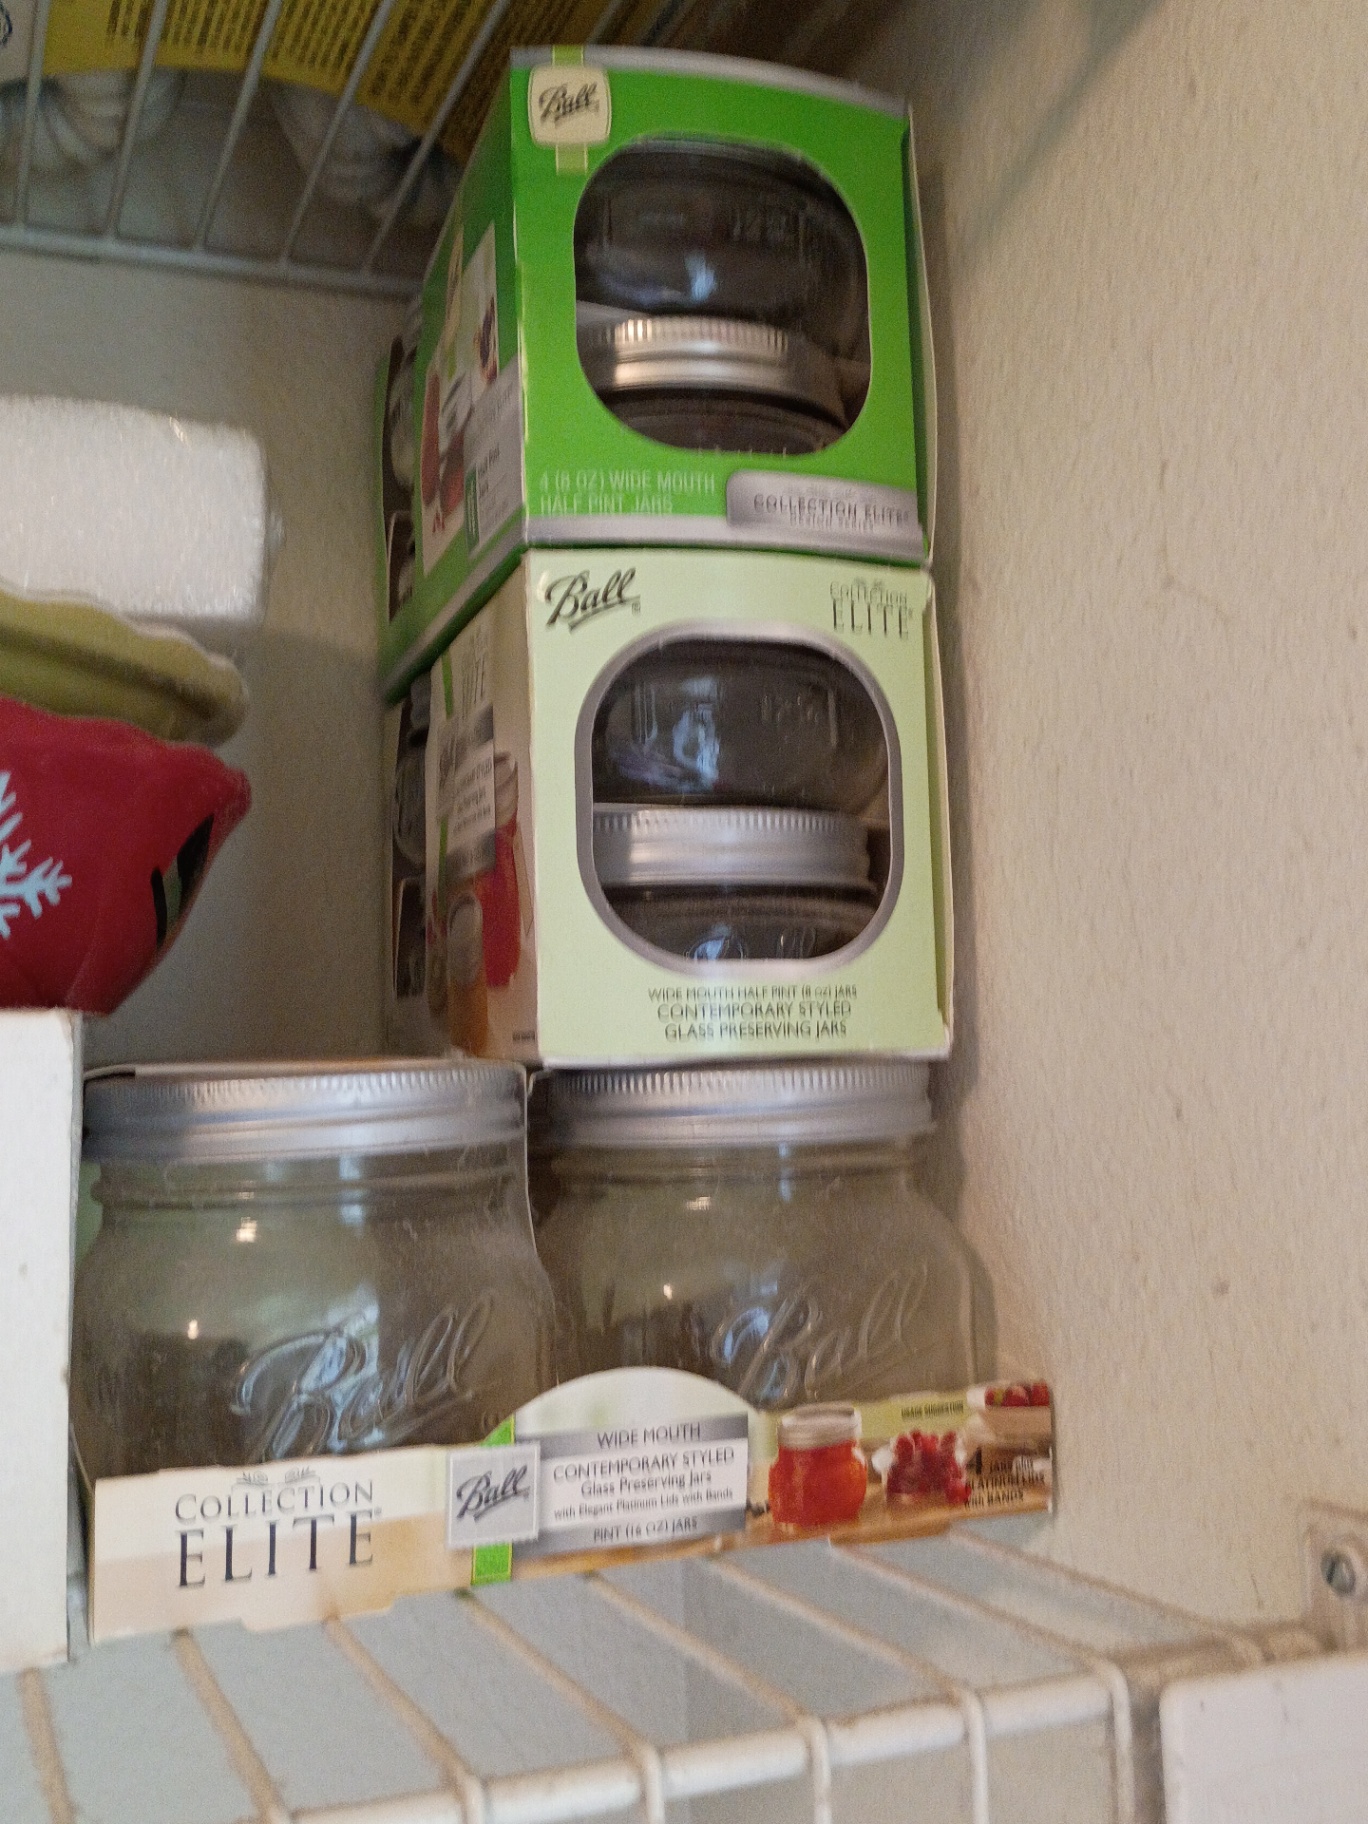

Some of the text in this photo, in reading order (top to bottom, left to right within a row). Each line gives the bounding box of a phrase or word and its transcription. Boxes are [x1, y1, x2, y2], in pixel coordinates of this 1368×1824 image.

[538, 82, 599, 126] Ball
[609, 470, 651, 494] WIDE
[657, 471, 716, 496] MOUTH
[540, 493, 673, 515] HALF PINT JARS
[753, 493, 858, 520] COLLECTION
[544, 567, 640, 634] Ball
[829, 580, 908, 606] COLLECTION
[831, 599, 909, 640] ELITE
[648, 986, 682, 1001] WIDE
[686, 985, 733, 1000] MOUTH
[738, 985, 768, 1000] HALF
[771, 984, 798, 999] PINT
[834, 983, 858, 1000] JARS
[656, 1000, 852, 1023] CONTEMPORARY STYLED
[664, 1020, 847, 1042] GLASS PRESERVING JARS
[597, 1421, 701, 1449] WIDE MOUTH
[553, 1445, 735, 1484] CONTEMPORARY STYLED
[965, 1446, 983, 1475] 4
[456, 1465, 530, 1522] Ball
[581, 1468, 712, 1498] Glass Preserving Jars
[175, 1479, 374, 1524] COLLECTION
[554, 1504, 576, 1520] with
[579, 1501, 613, 1517] Elegant
[616, 1496, 658, 1512] Platinum
[660, 1493, 679, 1508] Lids
[682, 1489, 703, 1505] with
[593, 1525, 622, 1544] PINT
[672, 1515, 698, 1535] JARS
[176, 1508, 375, 1590] ELITE
